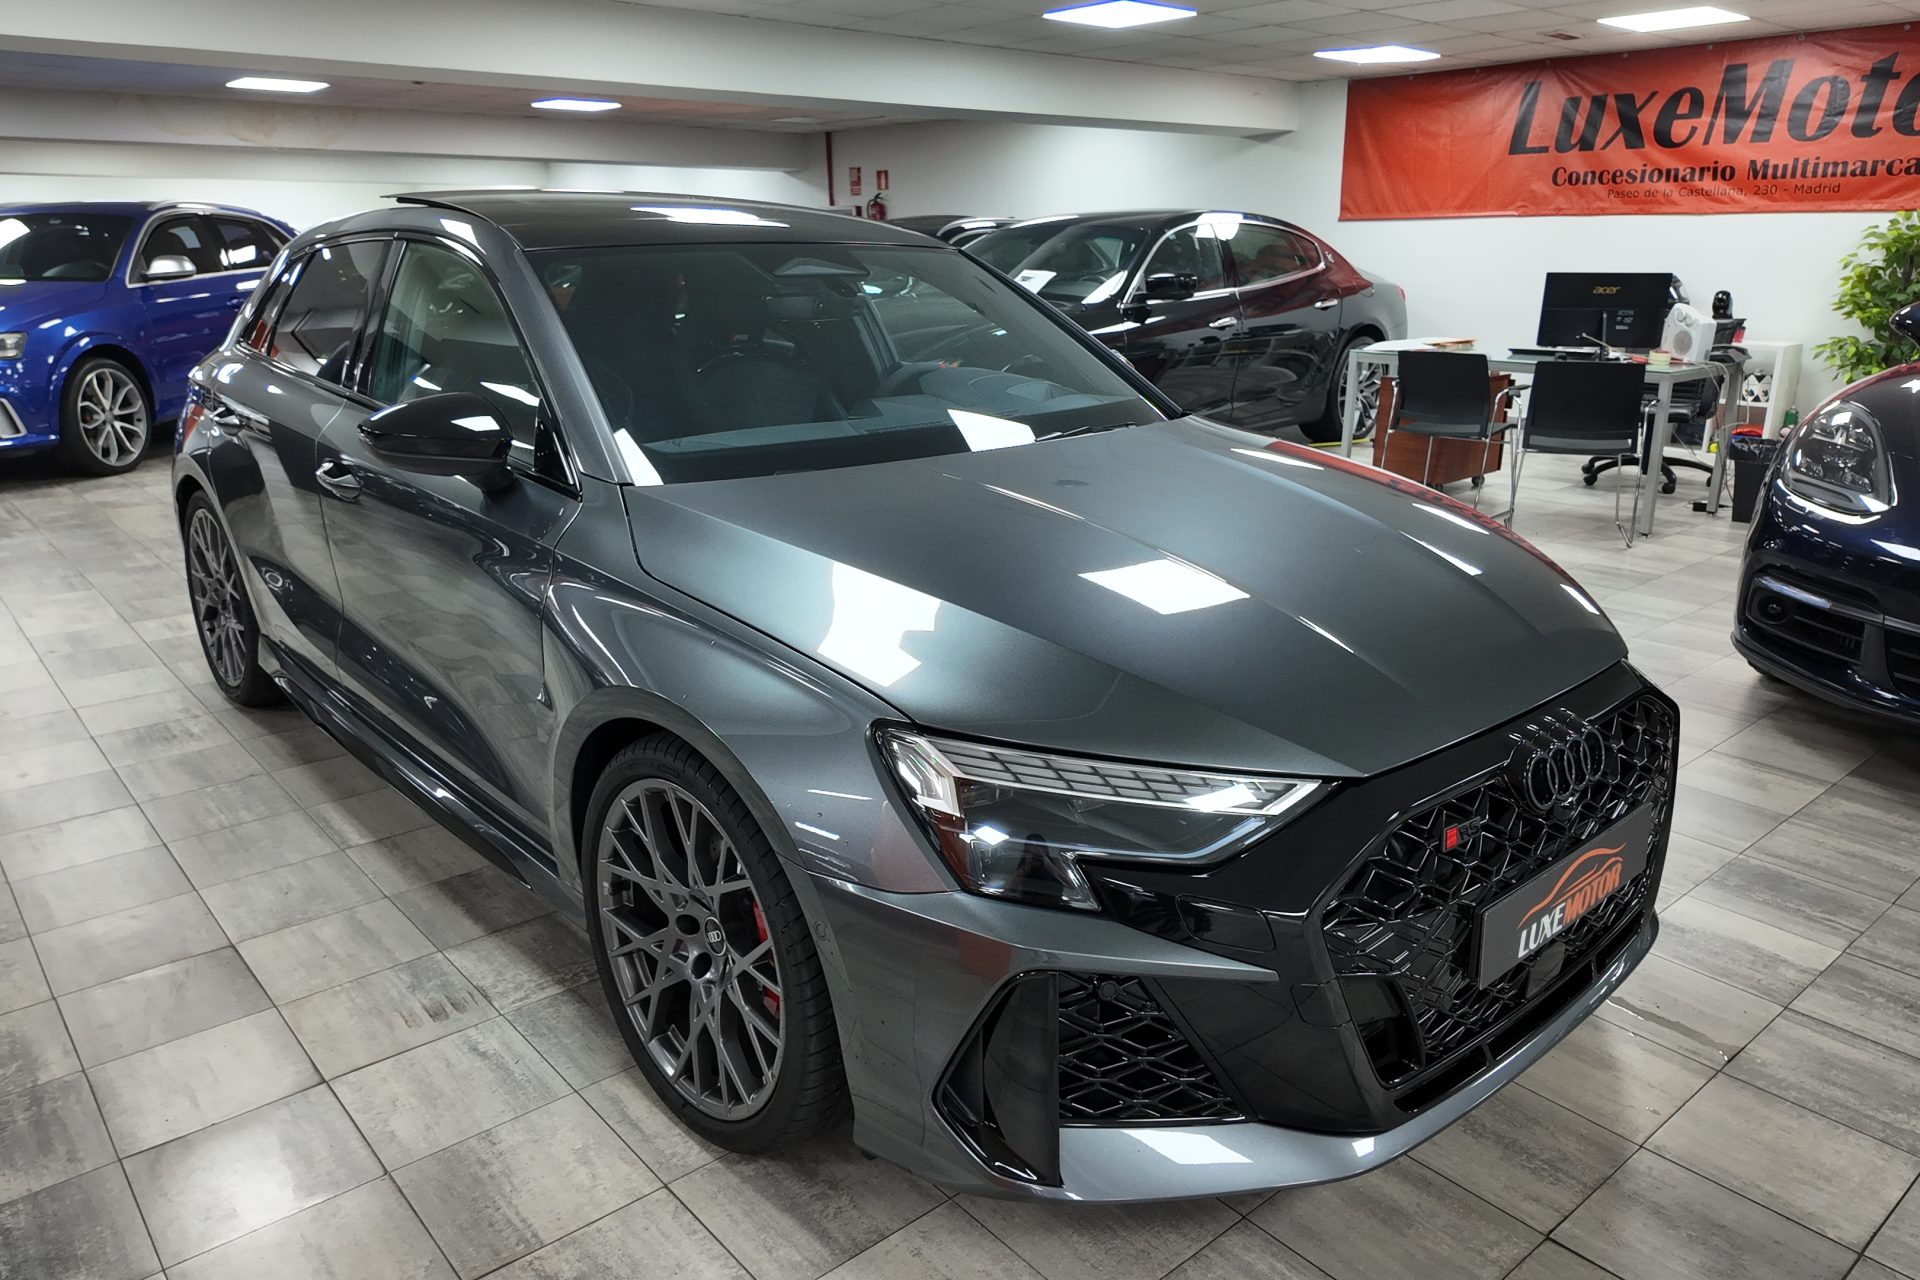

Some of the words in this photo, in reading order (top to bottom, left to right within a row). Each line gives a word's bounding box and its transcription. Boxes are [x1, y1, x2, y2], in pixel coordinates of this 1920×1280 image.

[1552, 160, 1736, 187] Concesionario
[1607, 188, 1640, 199] Paseo
[1644, 187, 1659, 198] de
[1663, 187, 1673, 198] la
[1679, 185, 1748, 197] Castellana,
[1753, 184, 1778, 196] 230
[1794, 183, 1841, 195] Madrid
[1592, 286, 1621, 294] acer
[1518, 862, 1622, 958] LUXEMOTOR
